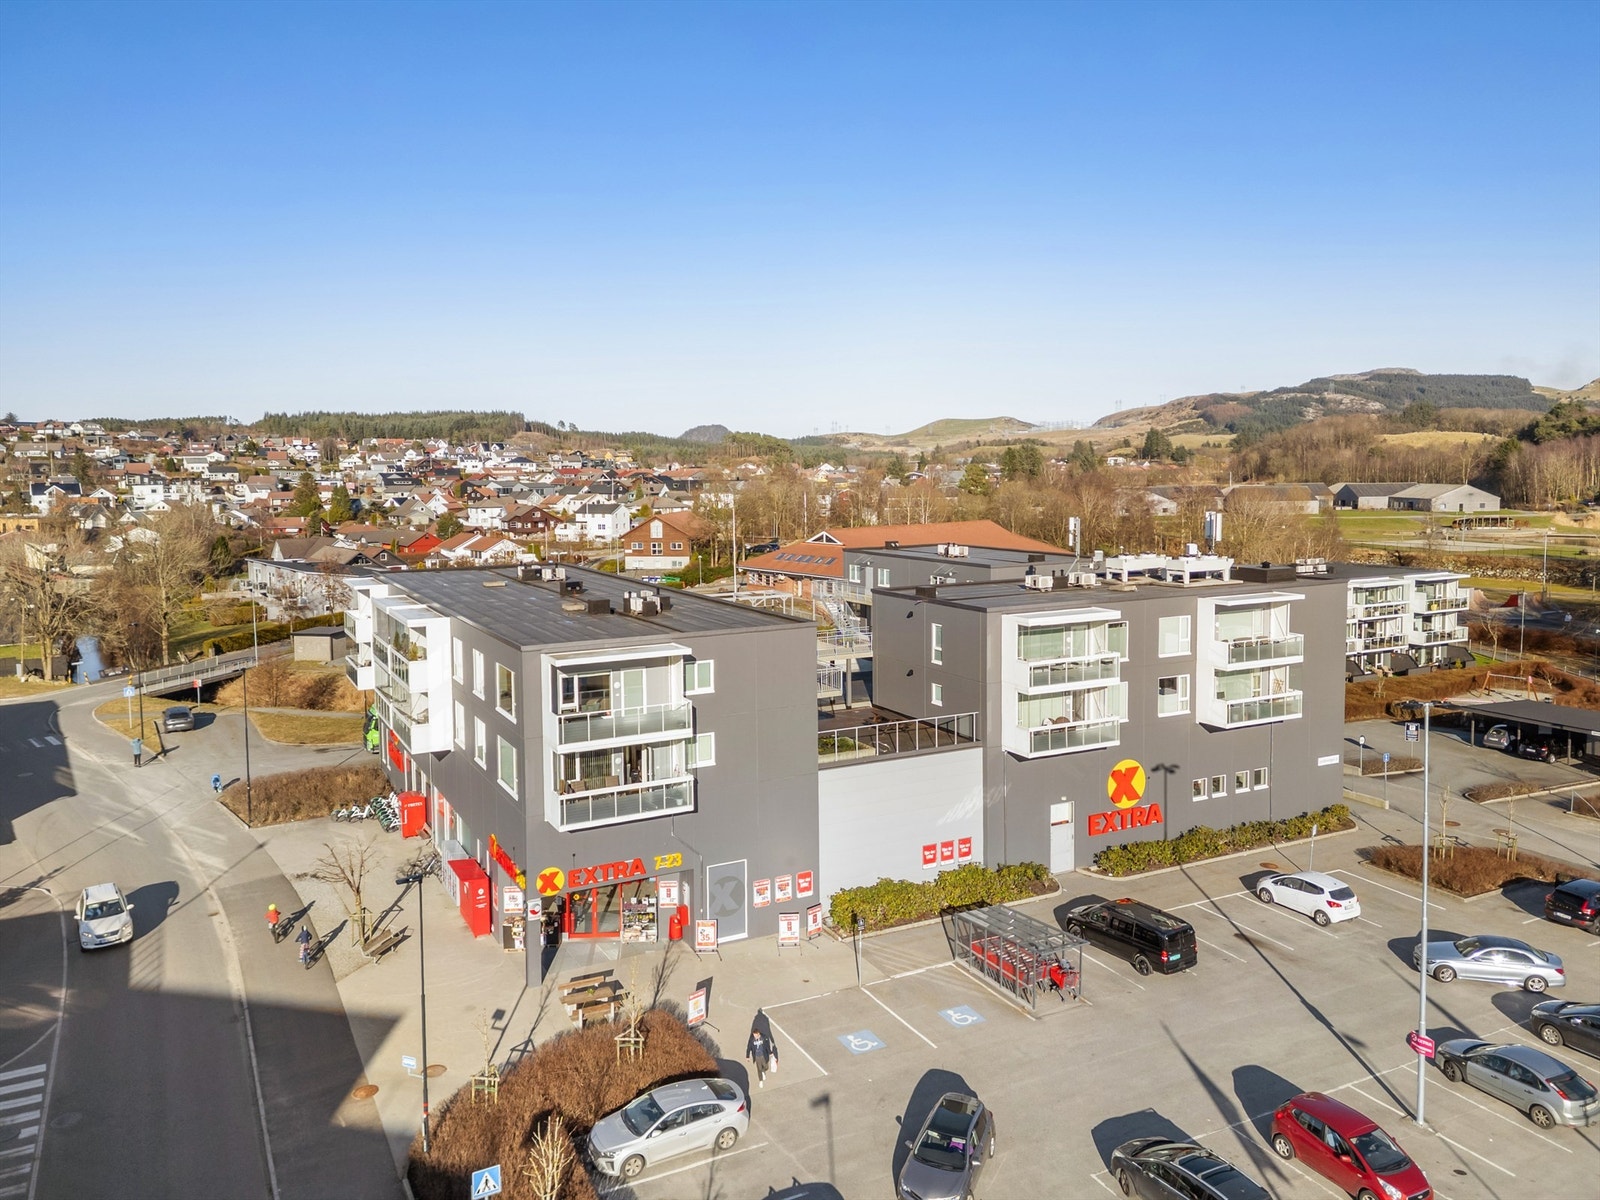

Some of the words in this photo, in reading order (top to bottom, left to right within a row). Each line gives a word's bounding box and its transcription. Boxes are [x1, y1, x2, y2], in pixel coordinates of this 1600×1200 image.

[1087, 803, 1164, 837] EXTRA
[567, 857, 647, 889] EXTRA
[654, 852, 683, 871] 7-23
